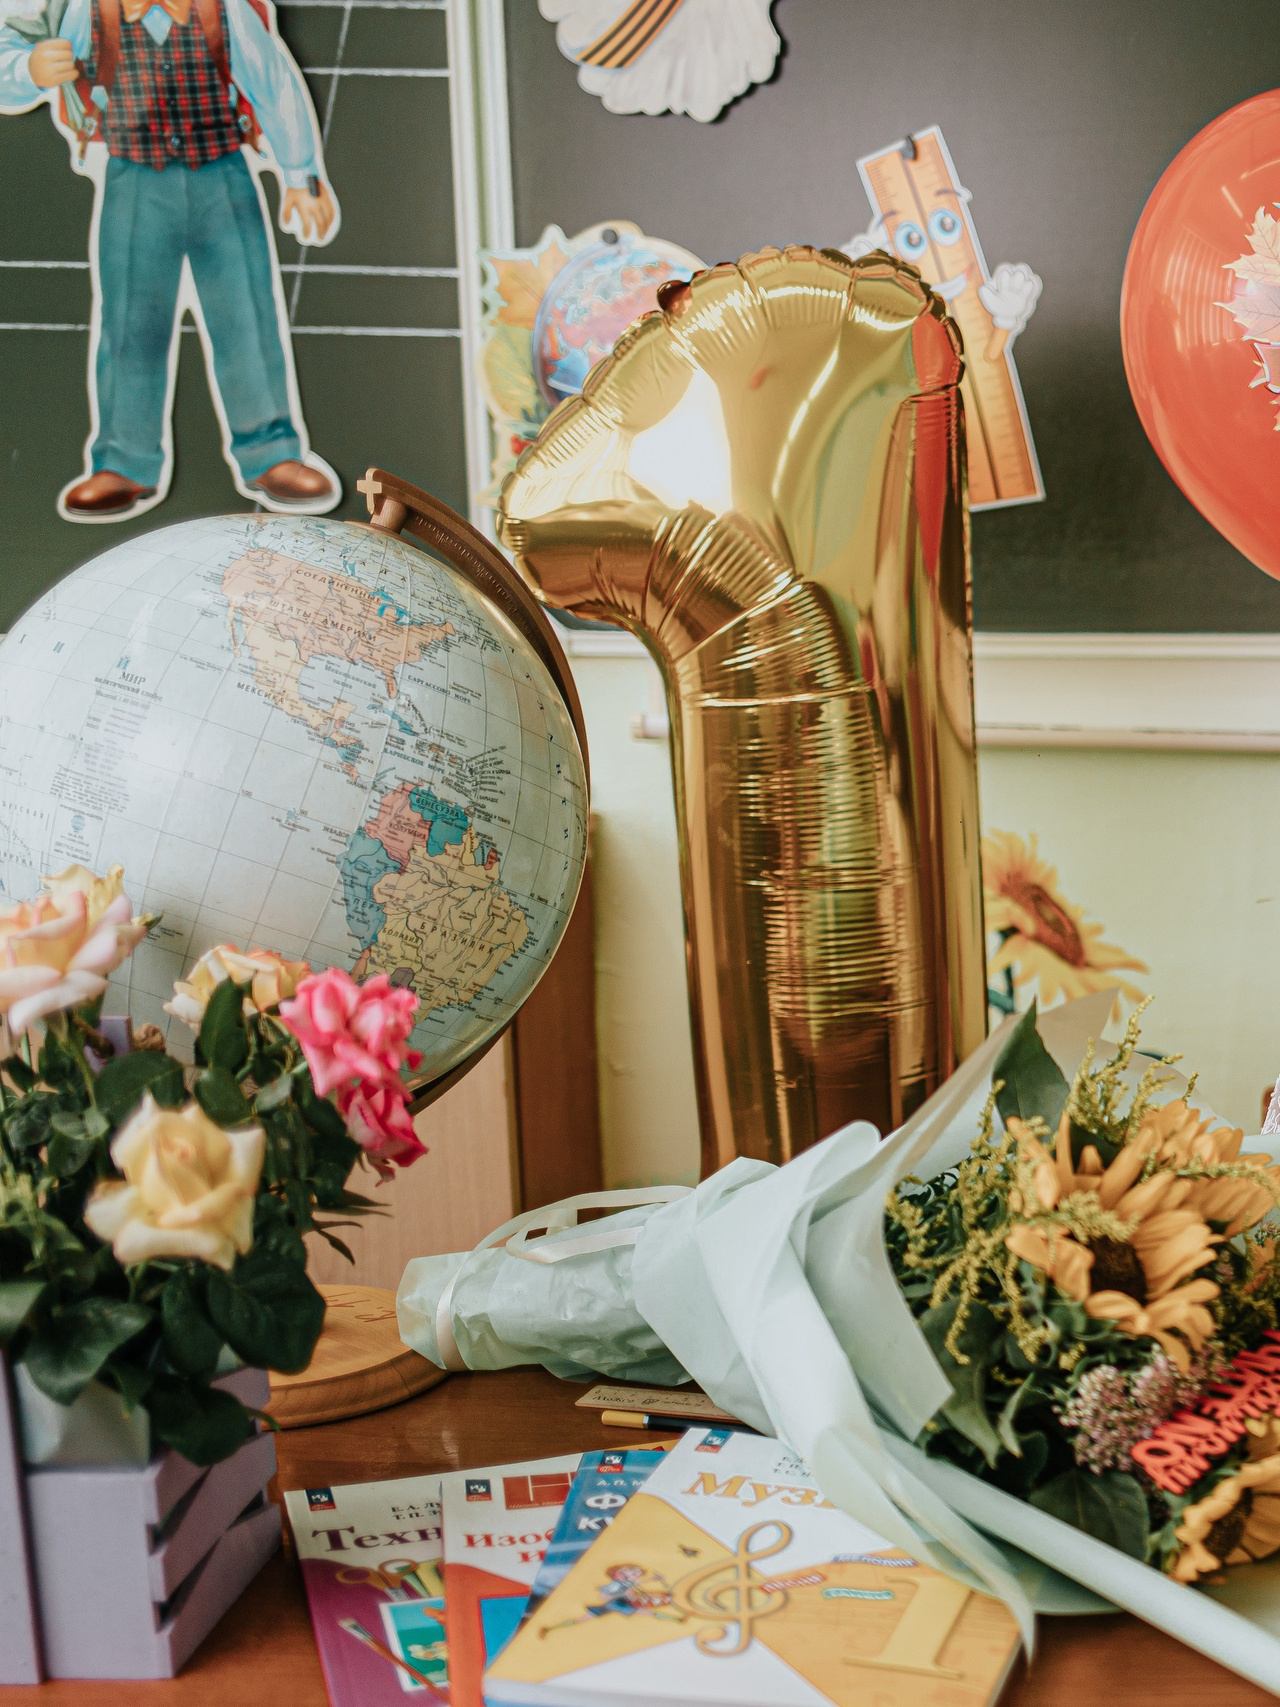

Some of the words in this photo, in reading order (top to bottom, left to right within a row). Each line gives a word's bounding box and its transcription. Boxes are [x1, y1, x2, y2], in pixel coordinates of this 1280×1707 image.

[269, 598, 313, 620] ШТАТЫ
[321, 618, 378, 643] АМЕРИКИ
[118, 671, 147, 686] МИР
[236, 681, 286, 705] МЕКСИКА
[415, 797, 461, 819] ВЕНЕСУЭЛА
[389, 821, 428, 841] КОЛУМБИЯ
[353, 898, 382, 912] ПЕРУ
[381, 926, 421, 944] БОЛИВИЯ
[420, 921, 495, 955] БРАЗИЛИЯ
